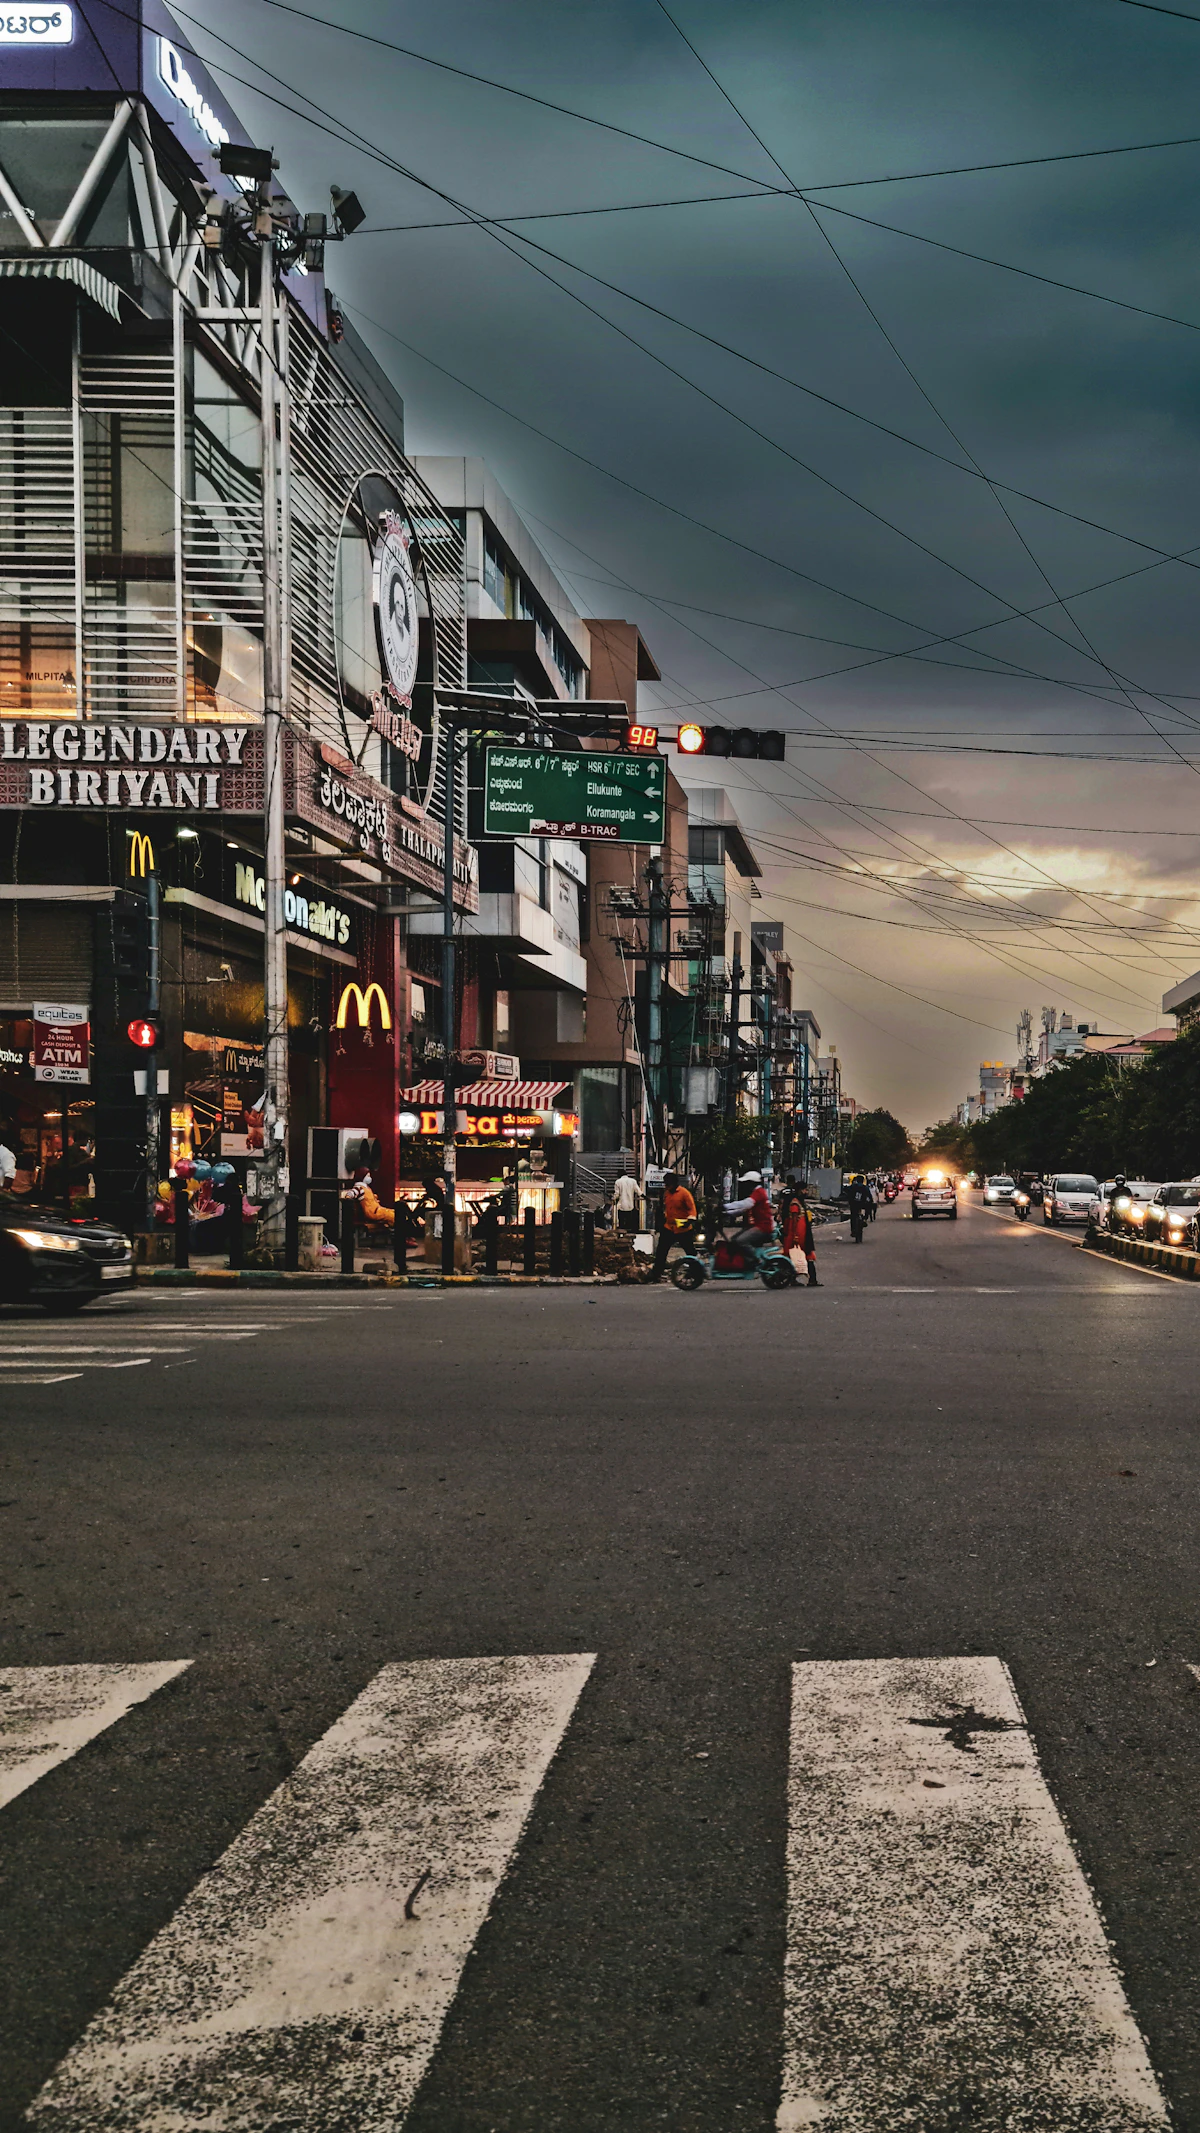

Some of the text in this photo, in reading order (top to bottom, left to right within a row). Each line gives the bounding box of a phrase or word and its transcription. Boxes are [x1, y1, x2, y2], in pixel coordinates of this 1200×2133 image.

[26, 671, 72, 681] MILPITA
[1, 723, 247, 765] LEGENDARY
[630, 727, 656, 746] 98
[587, 761, 603, 774] HSR
[625, 763, 640, 776] SEC
[29, 769, 220, 809] BIRIYANI
[587, 782, 622, 797] Ellukunte
[586, 805, 636, 822] Koramangala
[580, 825, 617, 836] B-TRAC
[401, 825, 468, 884] THALAPPAATTI
[234, 861, 350, 945] Mconald's
[38, 1008, 83, 1021] equitas
[42, 1048, 82, 1063] ATM
[420, 1111, 498, 1135] Dsa
